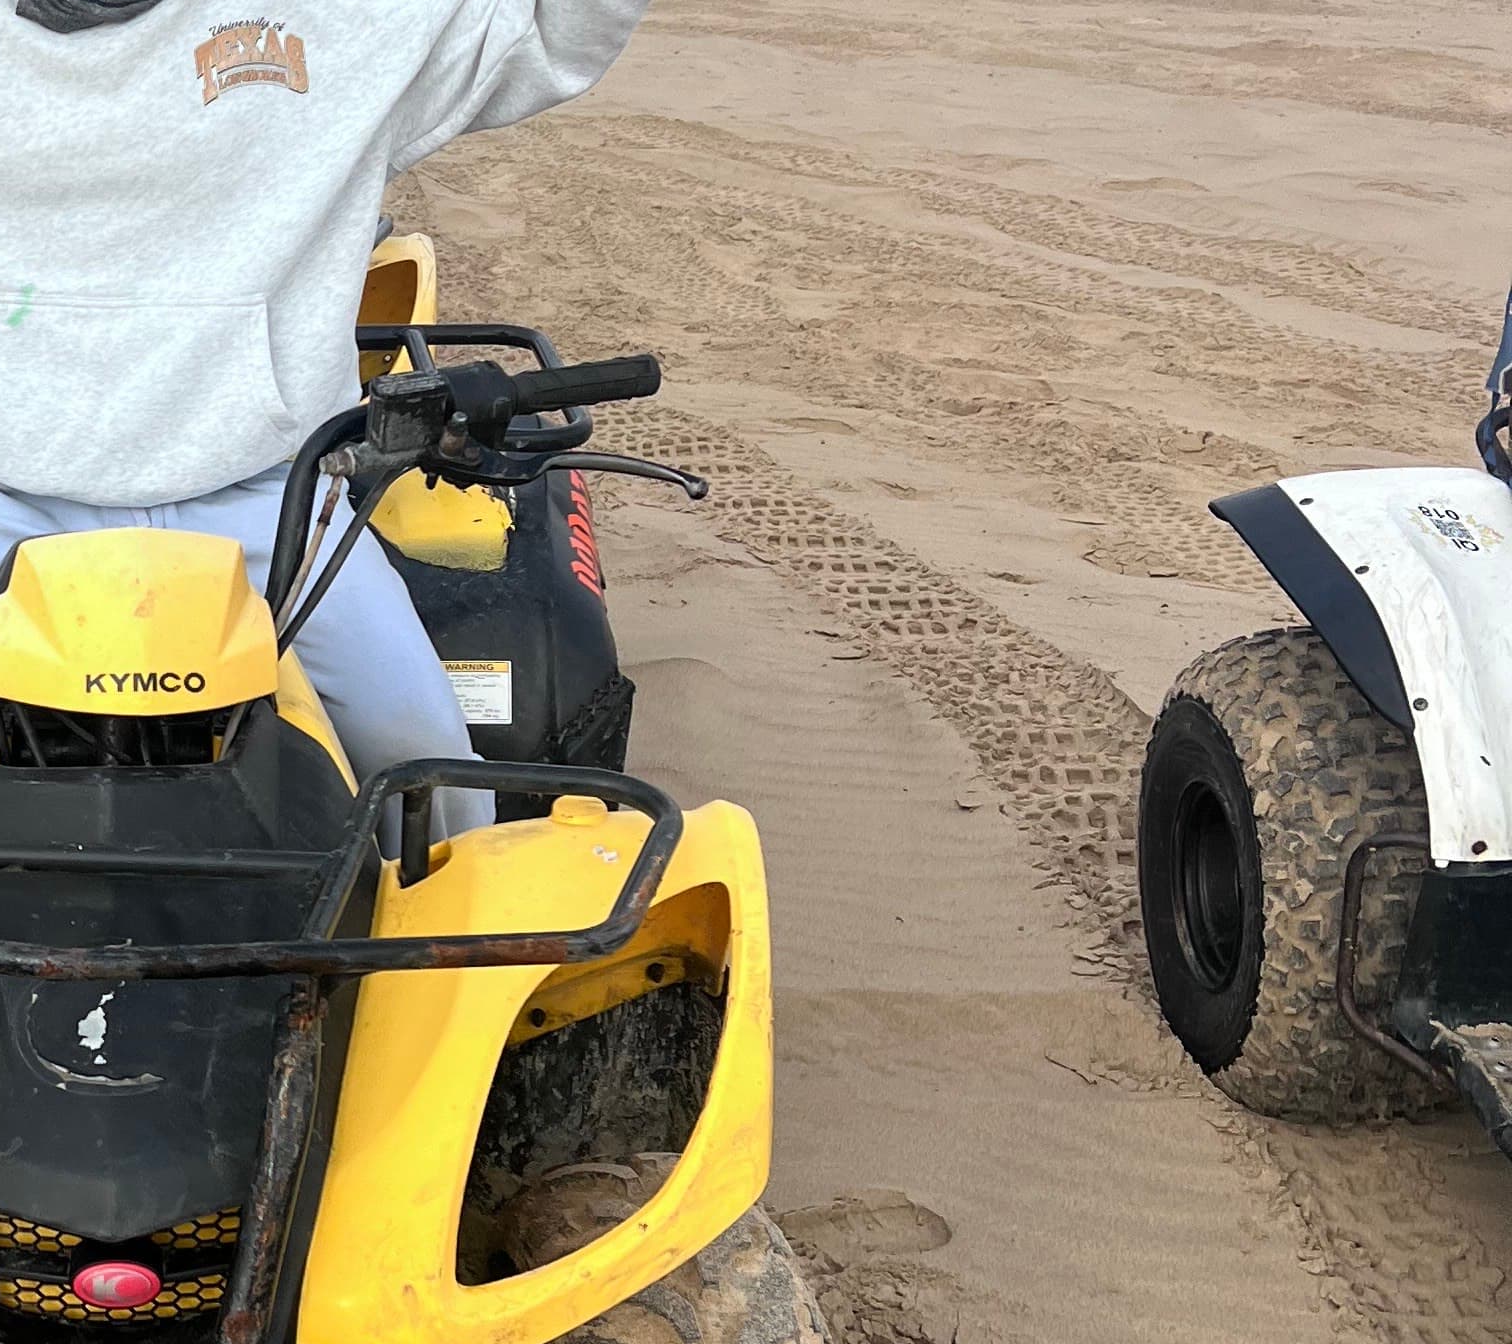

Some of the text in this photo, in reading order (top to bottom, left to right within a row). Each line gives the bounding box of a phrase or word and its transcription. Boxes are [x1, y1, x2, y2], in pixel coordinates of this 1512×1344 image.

[208, 16, 287, 37] University of
[194, 26, 310, 107] TEXAS
[444, 663, 495, 671] WARNING
[85, 672, 206, 693] KYMCO
